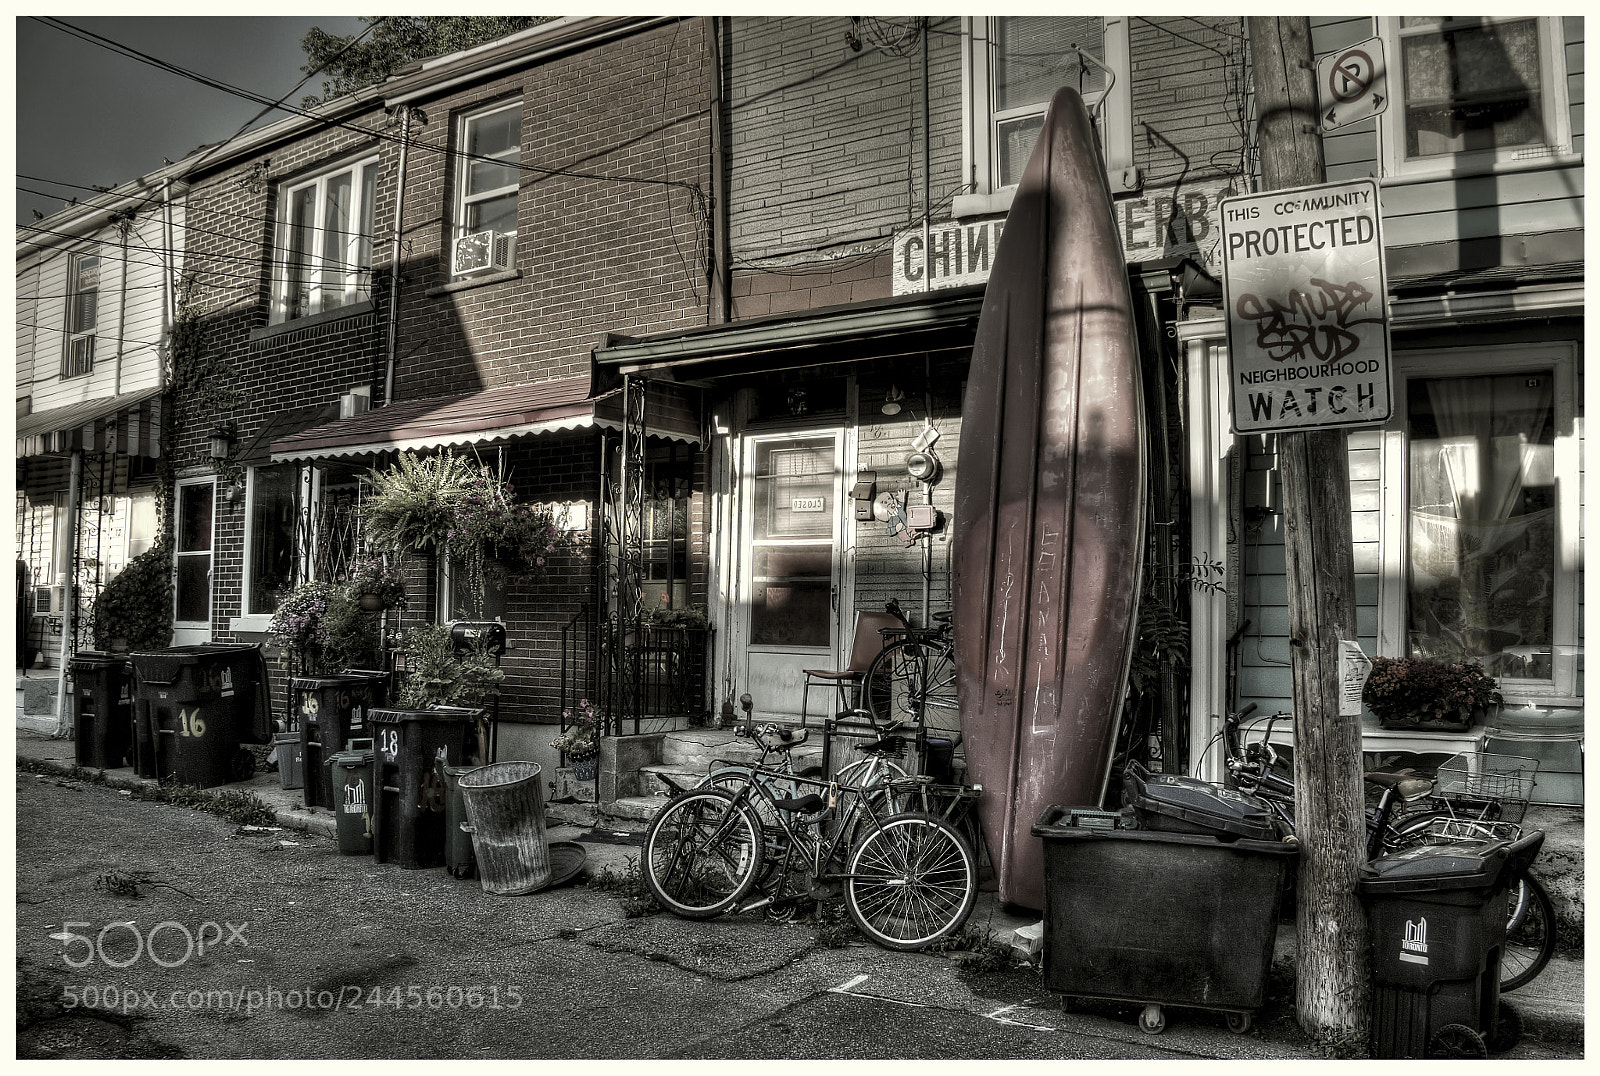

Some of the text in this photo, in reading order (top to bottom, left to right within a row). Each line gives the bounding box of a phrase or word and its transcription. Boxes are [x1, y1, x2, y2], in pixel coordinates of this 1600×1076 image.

[1227, 206, 1260, 222] THIS
[1228, 215, 1374, 261] PROTECTED
[1239, 359, 1380, 386] NEIGHBOURHOOD
[1247, 382, 1374, 422] WATCH
[301, 691, 319, 715] 16
[178, 707, 207, 738] 16
[380, 728, 398, 756] 18
[1401, 938, 1429, 953] TORONTO
